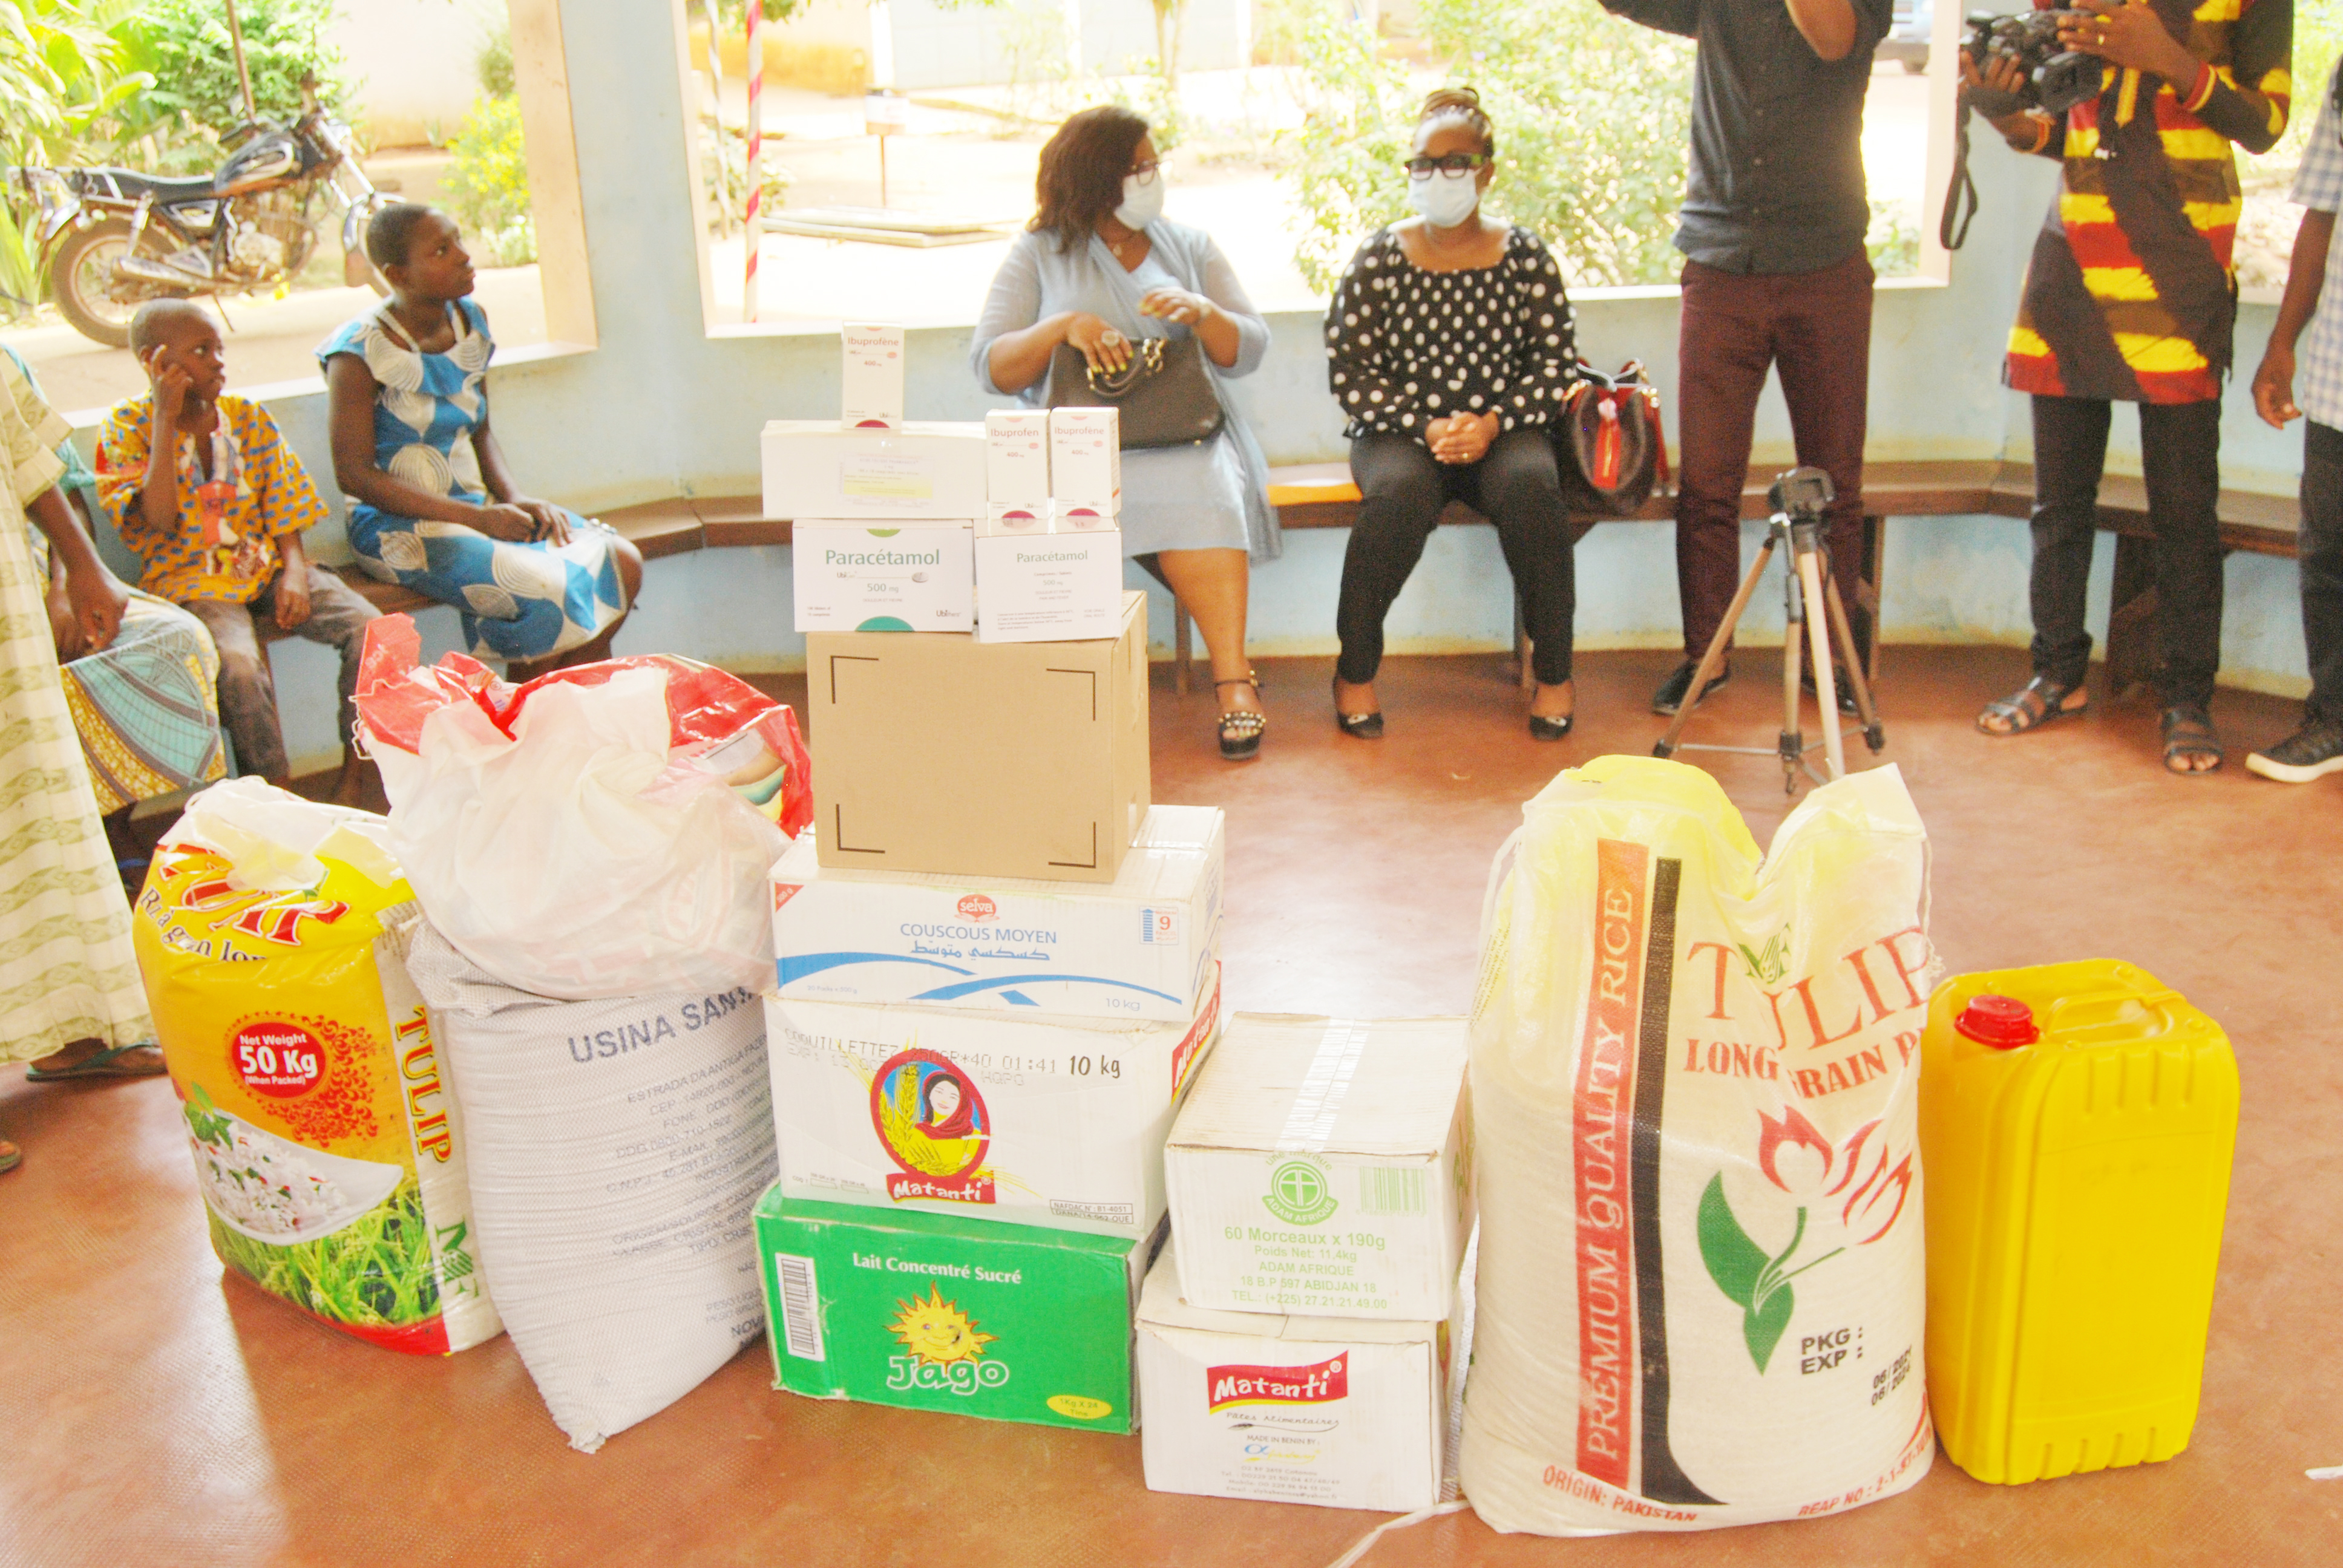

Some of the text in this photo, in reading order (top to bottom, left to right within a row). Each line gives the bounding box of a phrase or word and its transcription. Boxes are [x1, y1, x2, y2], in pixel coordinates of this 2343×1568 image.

[848, 337, 899, 347] Ibuprofène
[991, 427, 1039, 439] Ibuprofen
[1054, 426, 1104, 436] Ibuprofène
[825, 548, 940, 566] Paracétamol
[1016, 550, 1088, 563] Paracétamol
[867, 583, 886, 592] 500
[960, 898, 994, 913] selva
[1159, 915, 1171, 930] 9
[900, 923, 1057, 944] COUSCOUS MOYEN
[1106, 998, 1140, 1011] 10 kg
[240, 1033, 307, 1048] Net Weight
[568, 1014, 677, 1063] USINA
[240, 1045, 318, 1079] 50 Kg
[1070, 1054, 1121, 1079] 10 kg
[1683, 1038, 1888, 1099] LONG RAIN
[244, 1074, 306, 1086] (When Packed)
[395, 1004, 453, 1163] TULIP
[628, 1076, 689, 1103] ESTRADA
[650, 1099, 675, 1116] CEP
[1265, 1151, 1286, 1166] une
[1584, 889, 1634, 1460] PREMIUM QUALITY RICE
[893, 1179, 981, 1201] Matanti
[1266, 1197, 1335, 1223] ADAM AFRIQUE
[1225, 1227, 1385, 1250] 60 Morceaux x 190g
[1254, 1246, 1357, 1262] Poids Net: 11.4kg
[853, 1253, 1021, 1284] Lait Concentré Sucré
[1259, 1261, 1354, 1276] ADAM AFRIQUE
[1240, 1276, 1377, 1293] 18 B.P 597 ABIDJAN 18
[1265, 1291, 1301, 1306] (+225)
[1304, 1294, 1388, 1309] 27.21.21.49.00
[1801, 1328, 1850, 1355] PKG
[1800, 1349, 1848, 1376] EXP
[886, 1356, 1009, 1396] Jago
[1214, 1370, 1330, 1402] Matanti
[1263, 1415, 1339, 1426] Alimentaires
[1281, 1436, 1305, 1445] BENIN
[1542, 1465, 1698, 1523] ORIGIN: PAKISTAN
[1797, 1486, 1864, 1517] REAP NO
